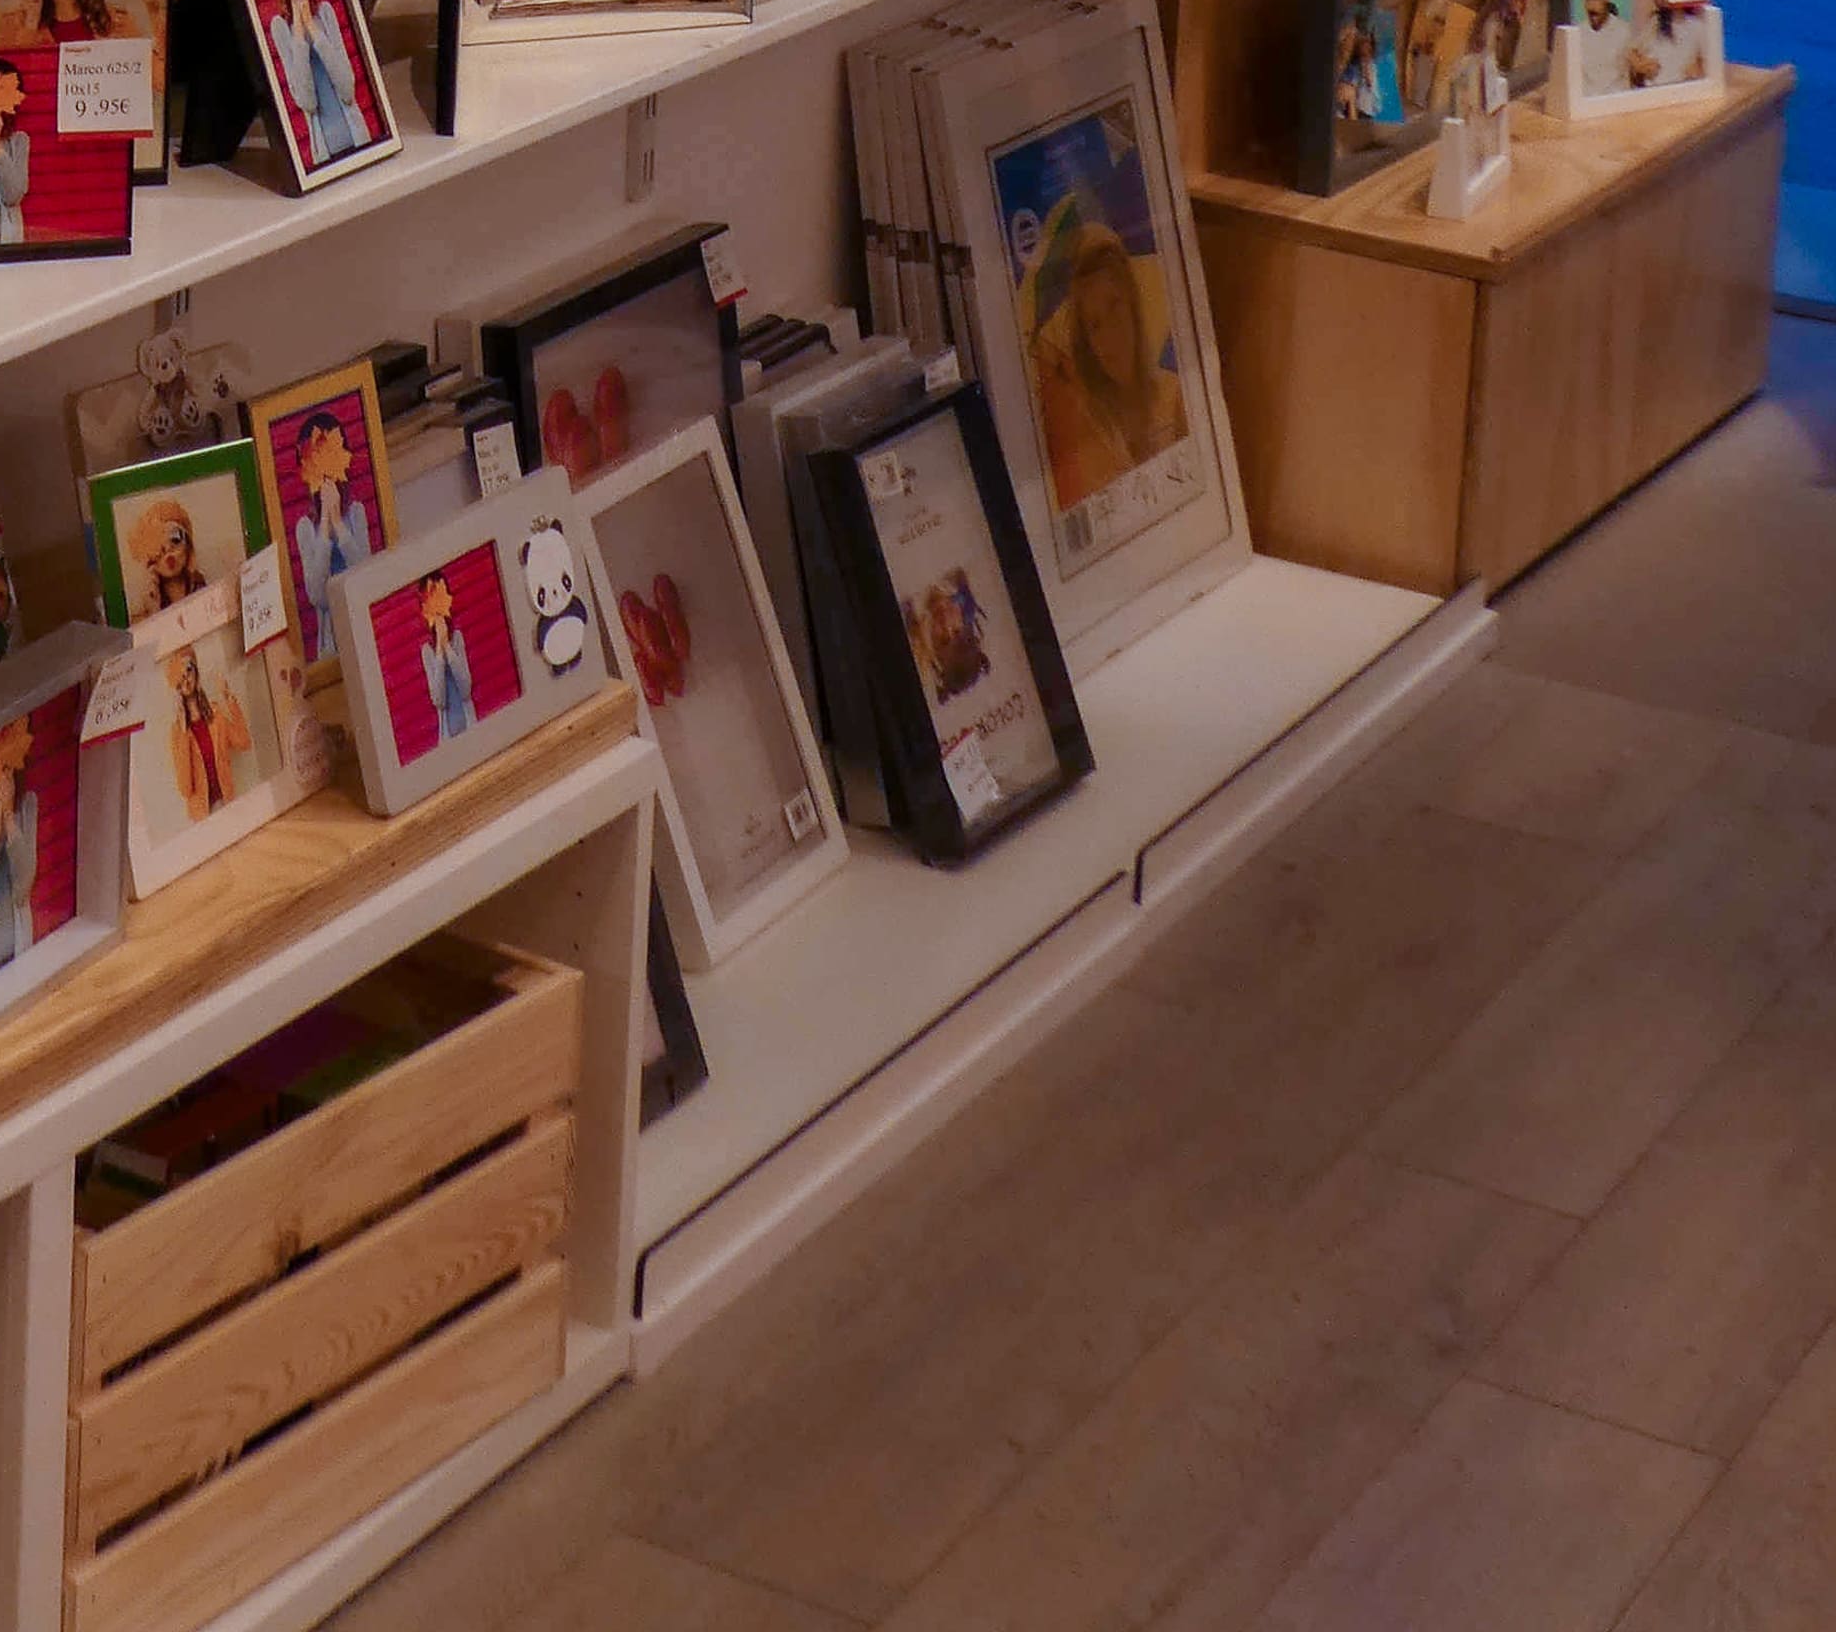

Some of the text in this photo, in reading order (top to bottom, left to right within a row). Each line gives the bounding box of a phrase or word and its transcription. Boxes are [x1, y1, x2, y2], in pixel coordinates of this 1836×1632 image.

[64, 62, 142, 75] Marco 625/2
[64, 83, 100, 96] 10x15
